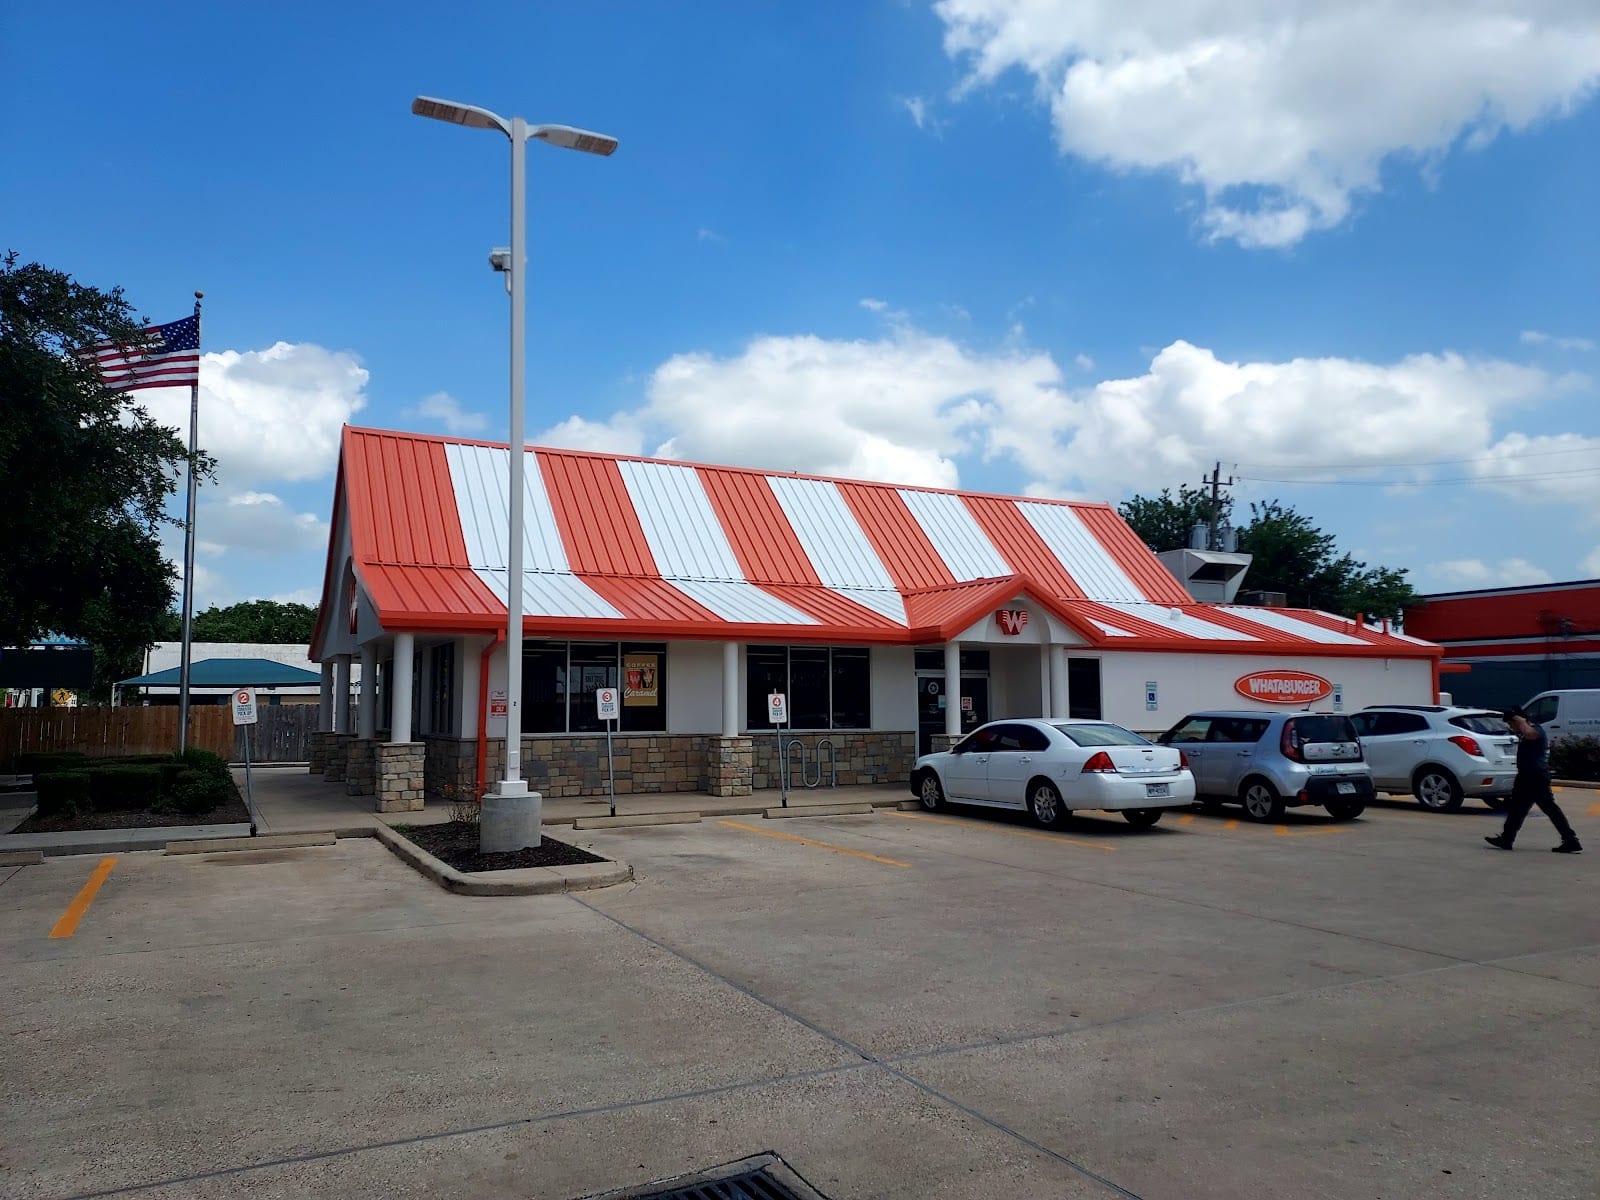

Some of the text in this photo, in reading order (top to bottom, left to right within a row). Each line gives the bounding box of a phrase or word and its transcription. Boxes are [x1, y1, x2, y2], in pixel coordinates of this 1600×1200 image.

[1001, 610, 1027, 633] W
[624, 687, 658, 699] Caramel
[1248, 679, 1321, 695] WHATABURGER
[240, 693, 248, 703] 2
[604, 693, 610, 701] 3
